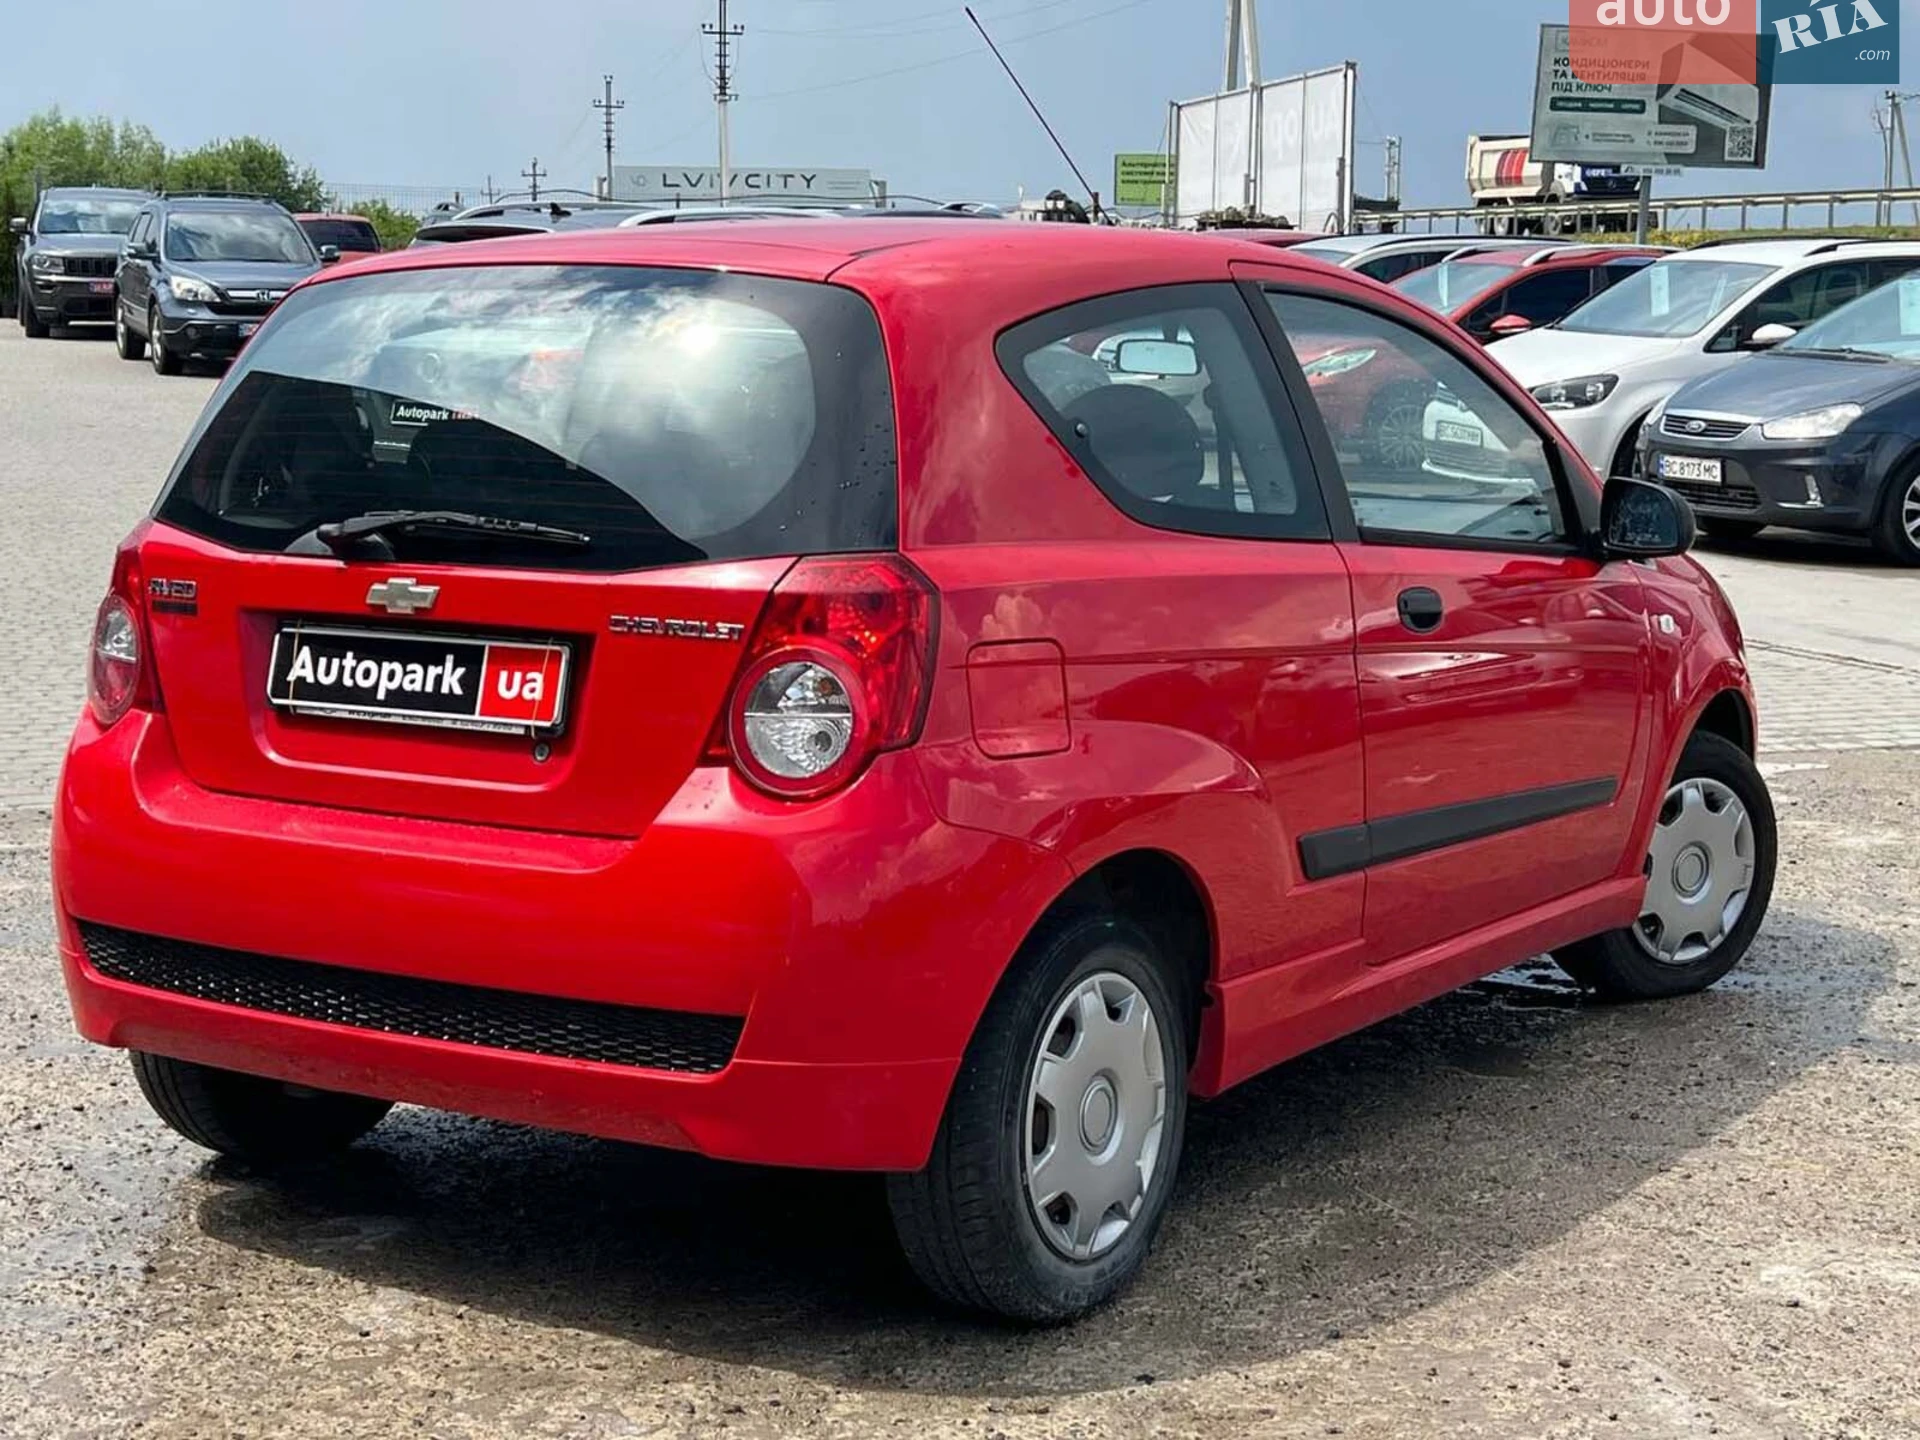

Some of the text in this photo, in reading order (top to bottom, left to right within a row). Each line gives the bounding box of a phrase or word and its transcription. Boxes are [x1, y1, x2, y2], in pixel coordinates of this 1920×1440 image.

[1553, 69, 1568, 80] ТА
[1551, 81, 1613, 93] ПІД КЛЮЧ
[396, 405, 450, 422] Autopark
[1665, 459, 1718, 479] BC 8173 MC
[609, 615, 745, 640] CHEVROLET
[286, 645, 544, 701] Autopark ua
